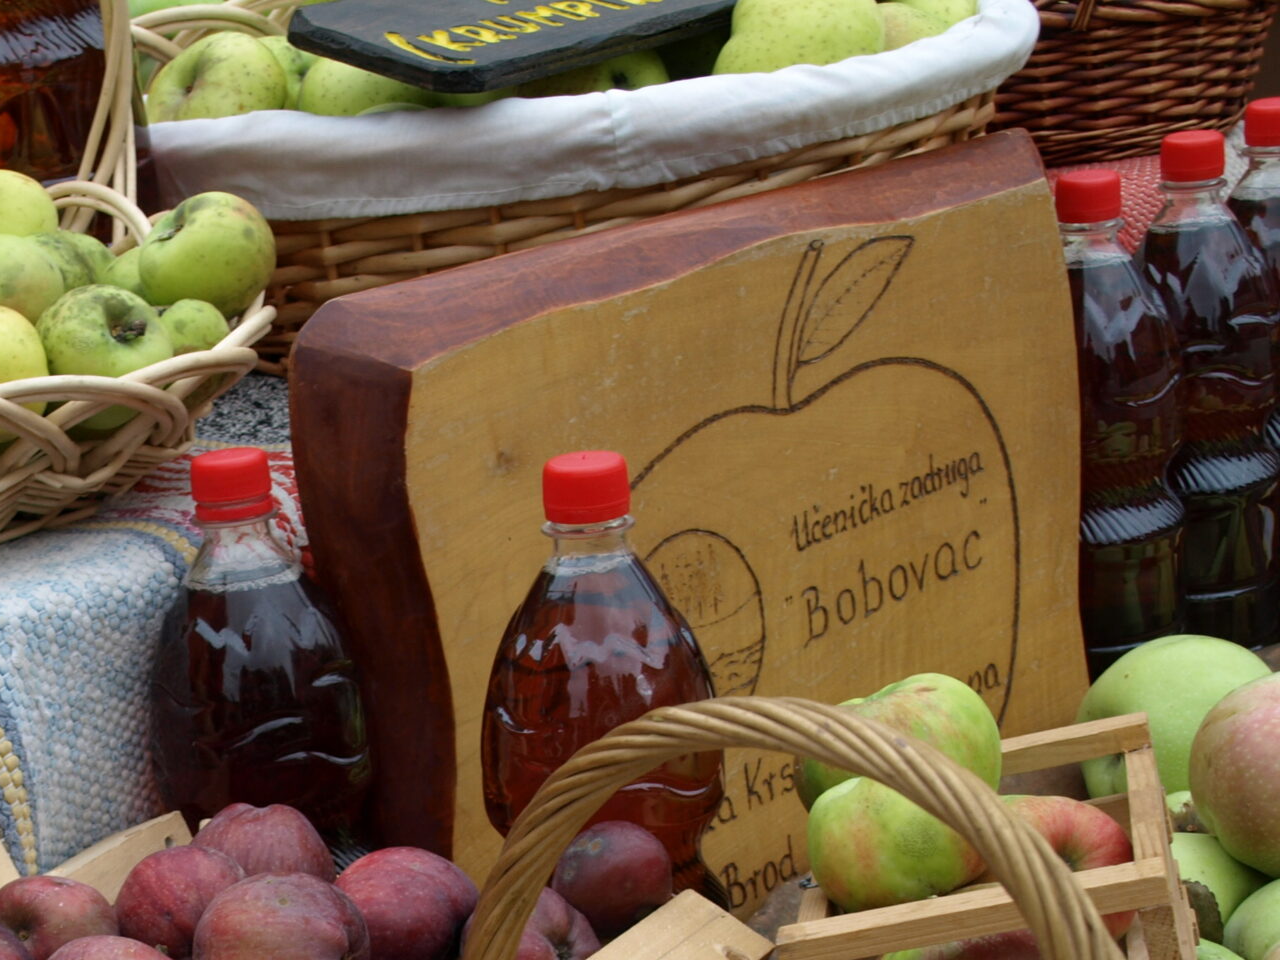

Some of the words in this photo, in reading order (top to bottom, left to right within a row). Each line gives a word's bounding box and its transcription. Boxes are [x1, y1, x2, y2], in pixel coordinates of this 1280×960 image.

[384, 0, 664, 64] (KRUMPI
[899, 452, 984, 508] zadruga
[743, 757, 795, 810] Krs
[719, 833, 798, 909] Brod
